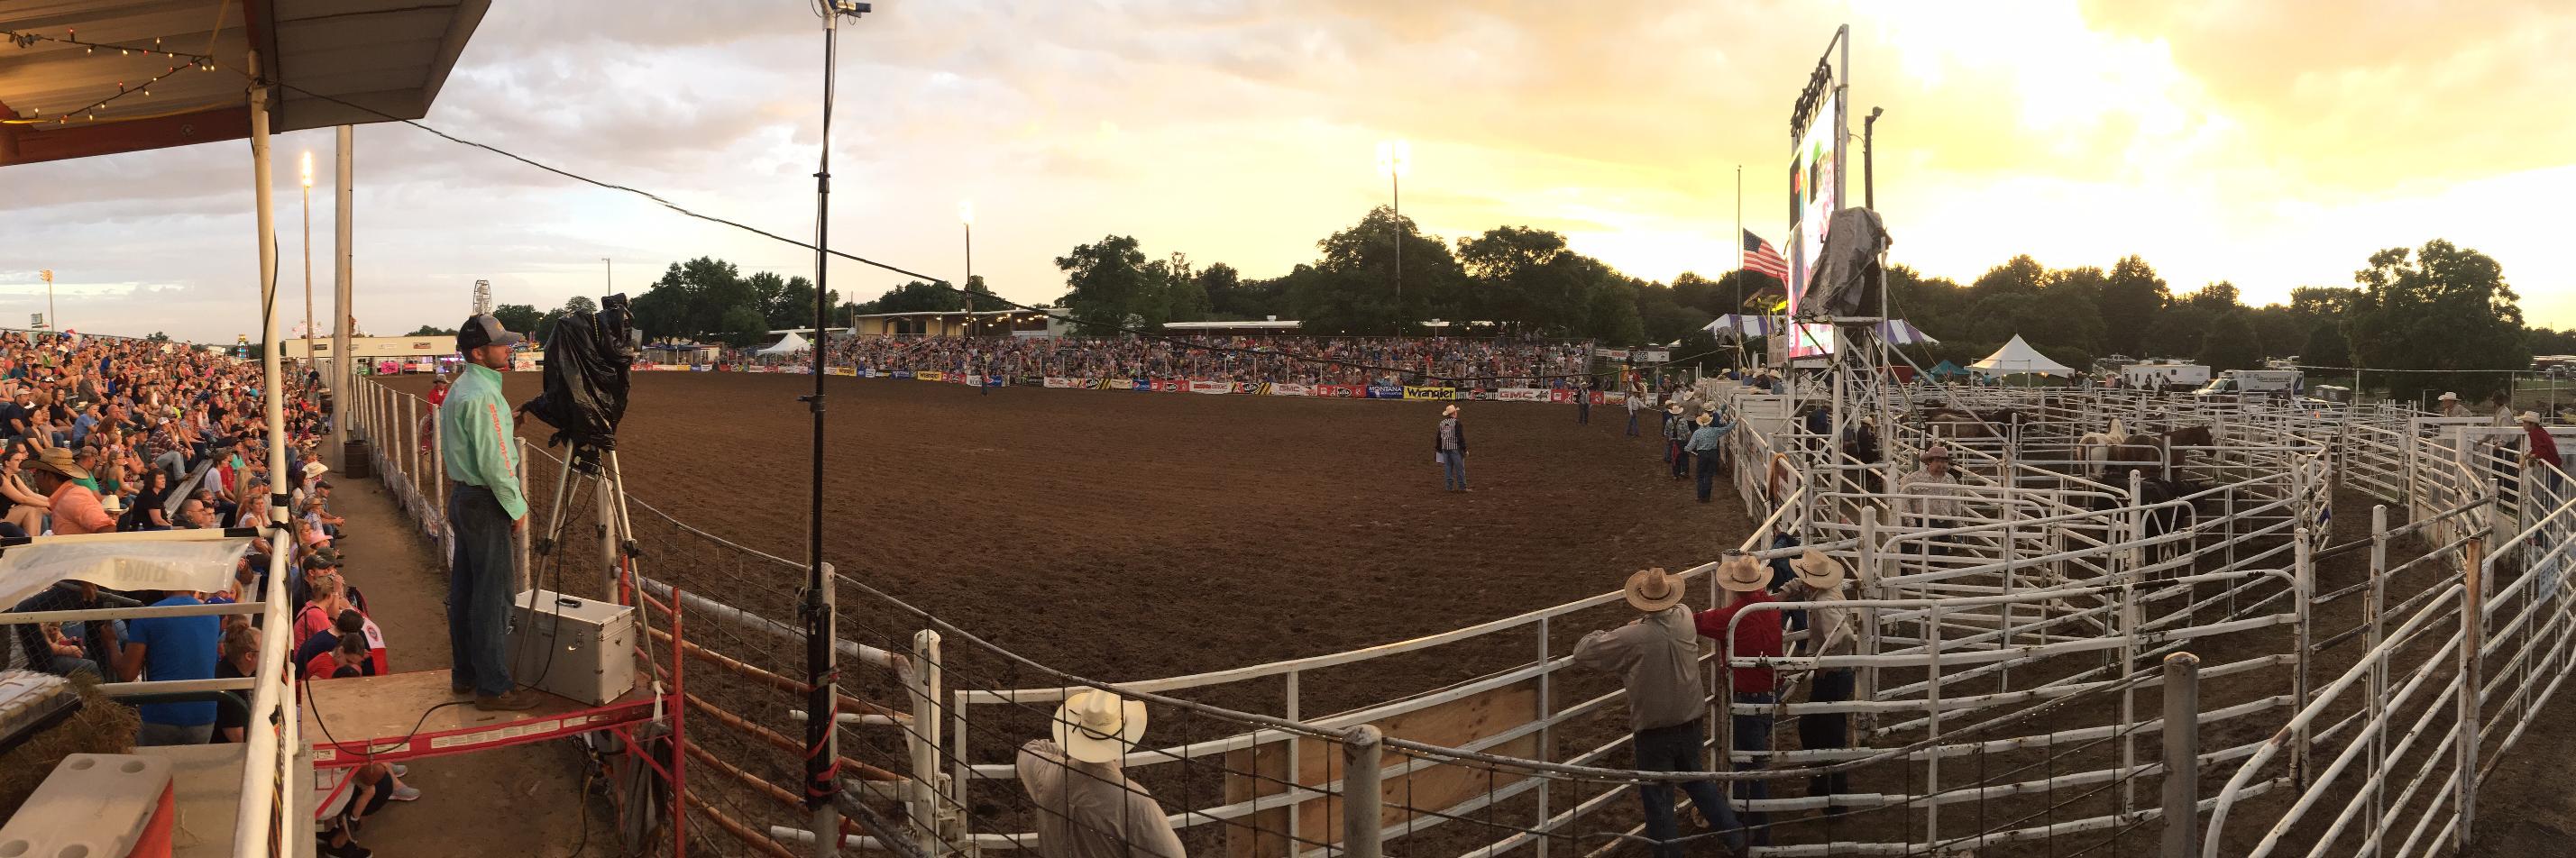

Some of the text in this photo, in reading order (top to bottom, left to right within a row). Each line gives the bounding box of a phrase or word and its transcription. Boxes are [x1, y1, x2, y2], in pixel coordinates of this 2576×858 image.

[919, 371, 940, 379] Wrangler
[1407, 388, 1453, 399] Wrangler
[1499, 390, 1534, 398] GMC
